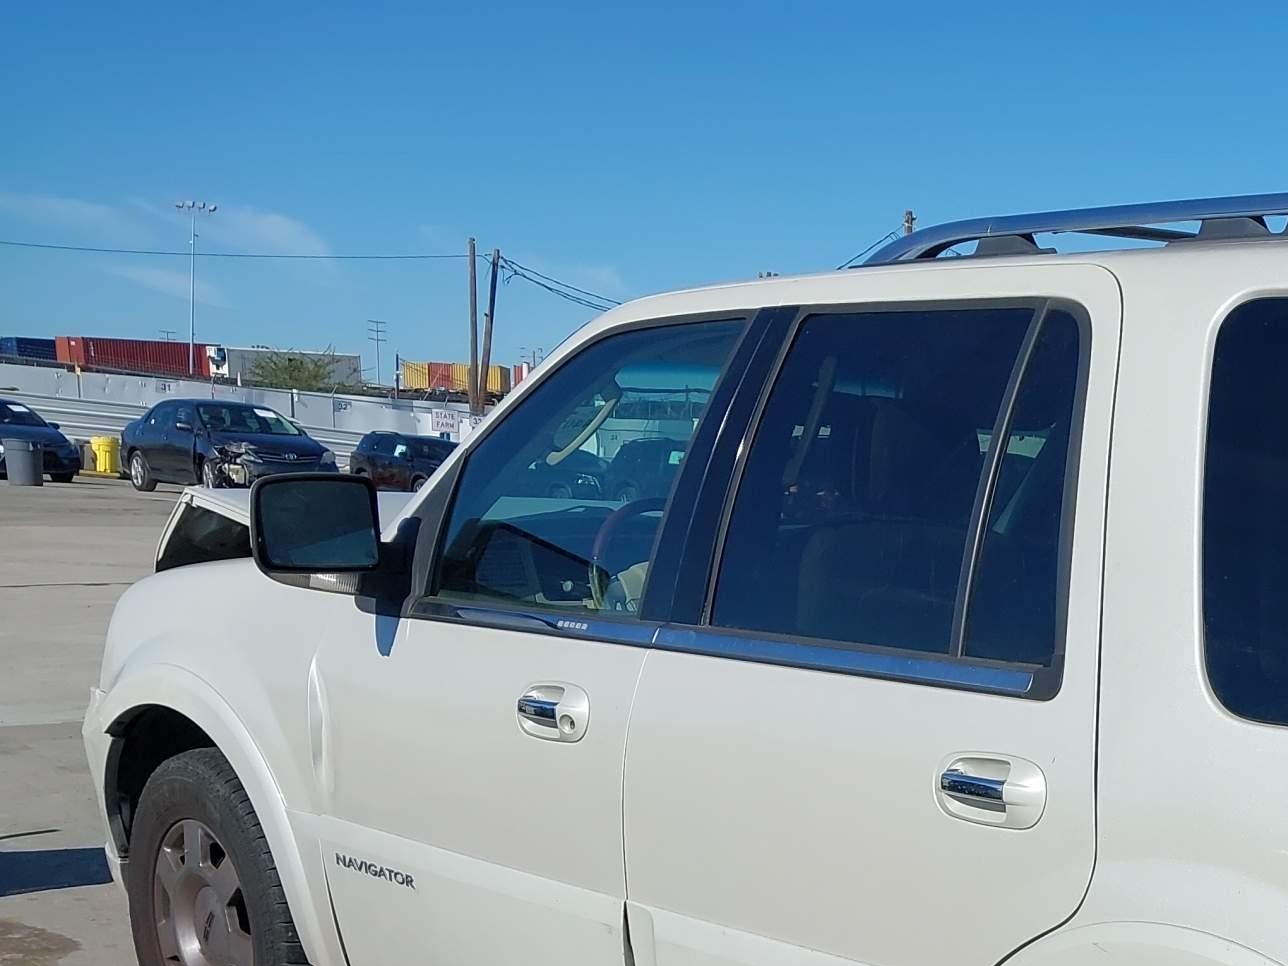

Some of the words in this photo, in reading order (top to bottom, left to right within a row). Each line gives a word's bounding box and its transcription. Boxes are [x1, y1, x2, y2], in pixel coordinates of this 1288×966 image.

[435, 411, 455, 420] STATE
[436, 420, 455, 429] FARM
[335, 852, 416, 890] NAVIGATOR
